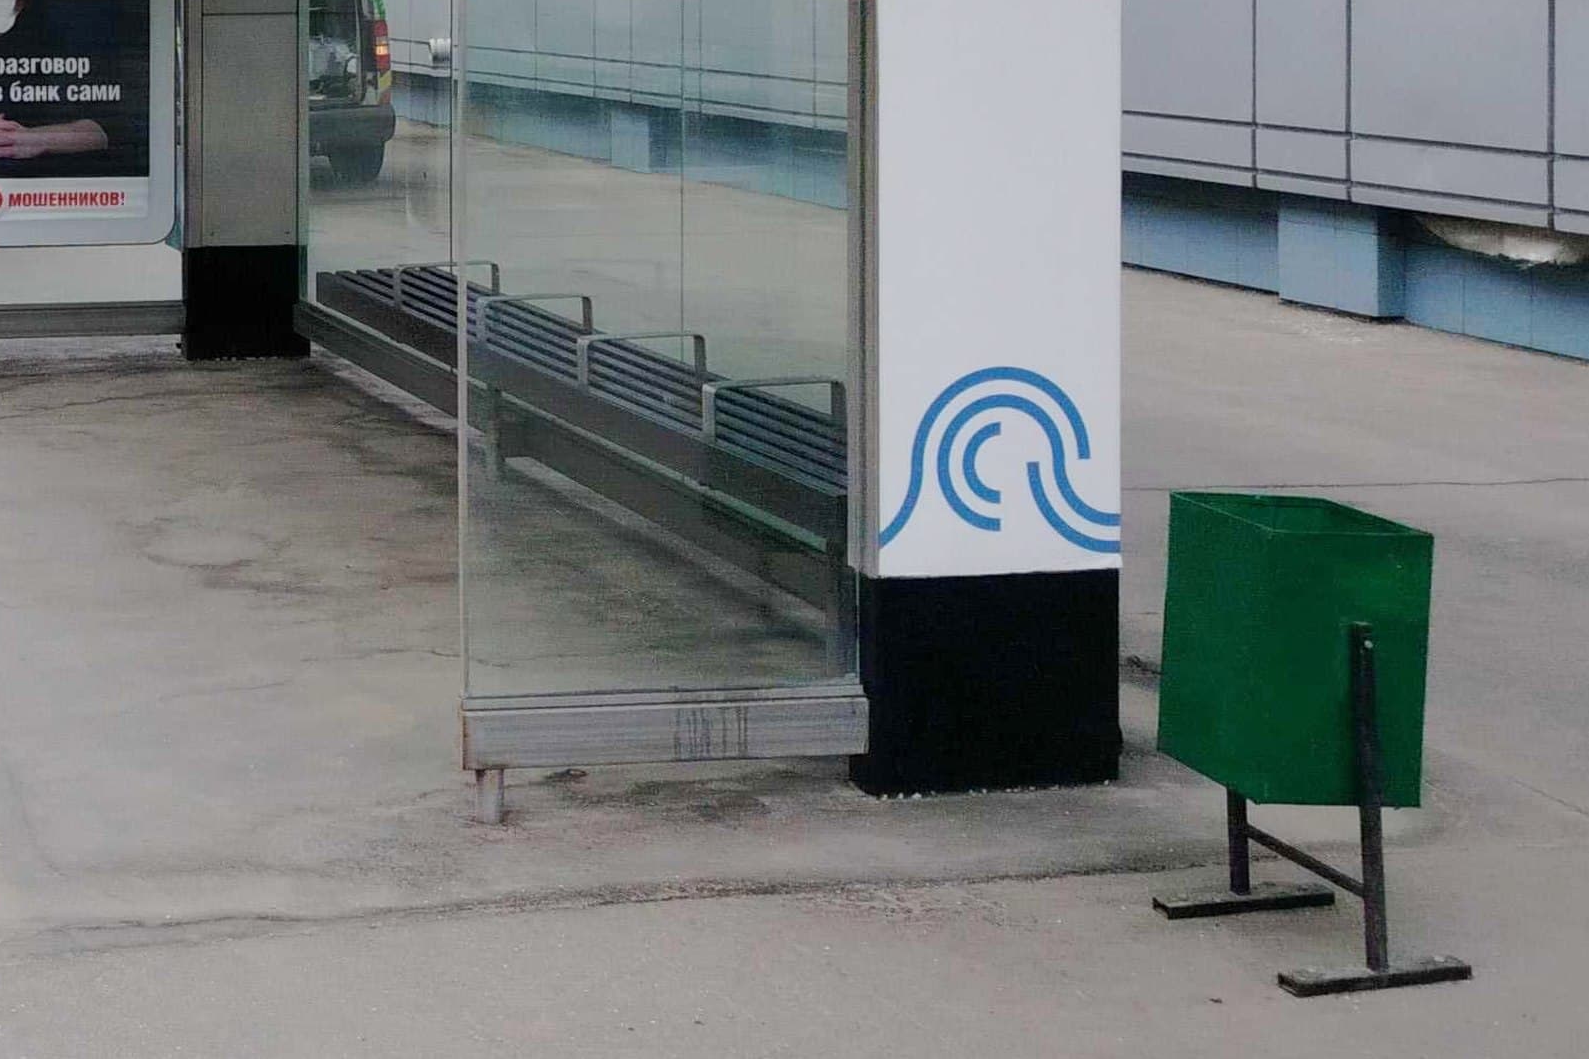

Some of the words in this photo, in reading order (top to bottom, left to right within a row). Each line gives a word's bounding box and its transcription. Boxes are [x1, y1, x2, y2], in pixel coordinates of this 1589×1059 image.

[10, 81, 60, 102] банк
[66, 84, 121, 101] сами
[8, 192, 125, 208] МОШЕННИКОВ!
